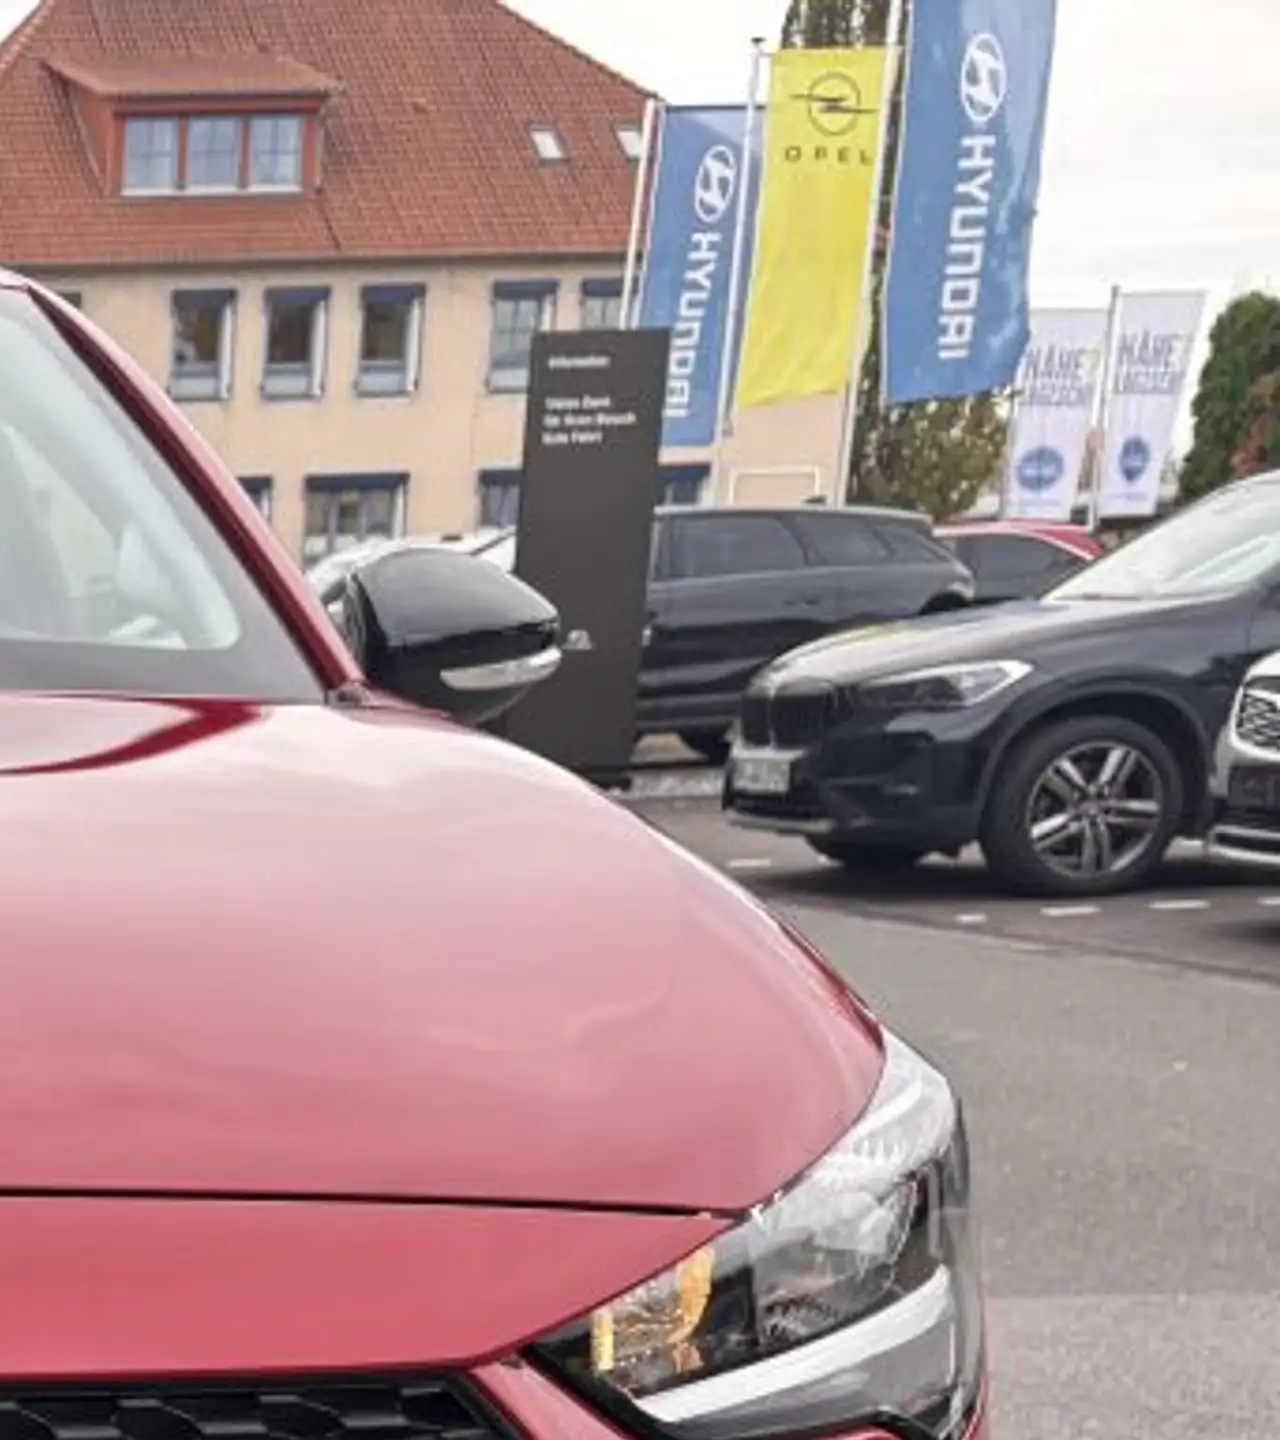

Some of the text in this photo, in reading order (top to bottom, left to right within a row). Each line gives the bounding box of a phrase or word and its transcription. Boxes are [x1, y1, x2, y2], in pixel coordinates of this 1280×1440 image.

[783, 144, 876, 167] OPEL
[937, 133, 997, 361] HYUNDAI
[661, 231, 723, 419] HYUNDAI
